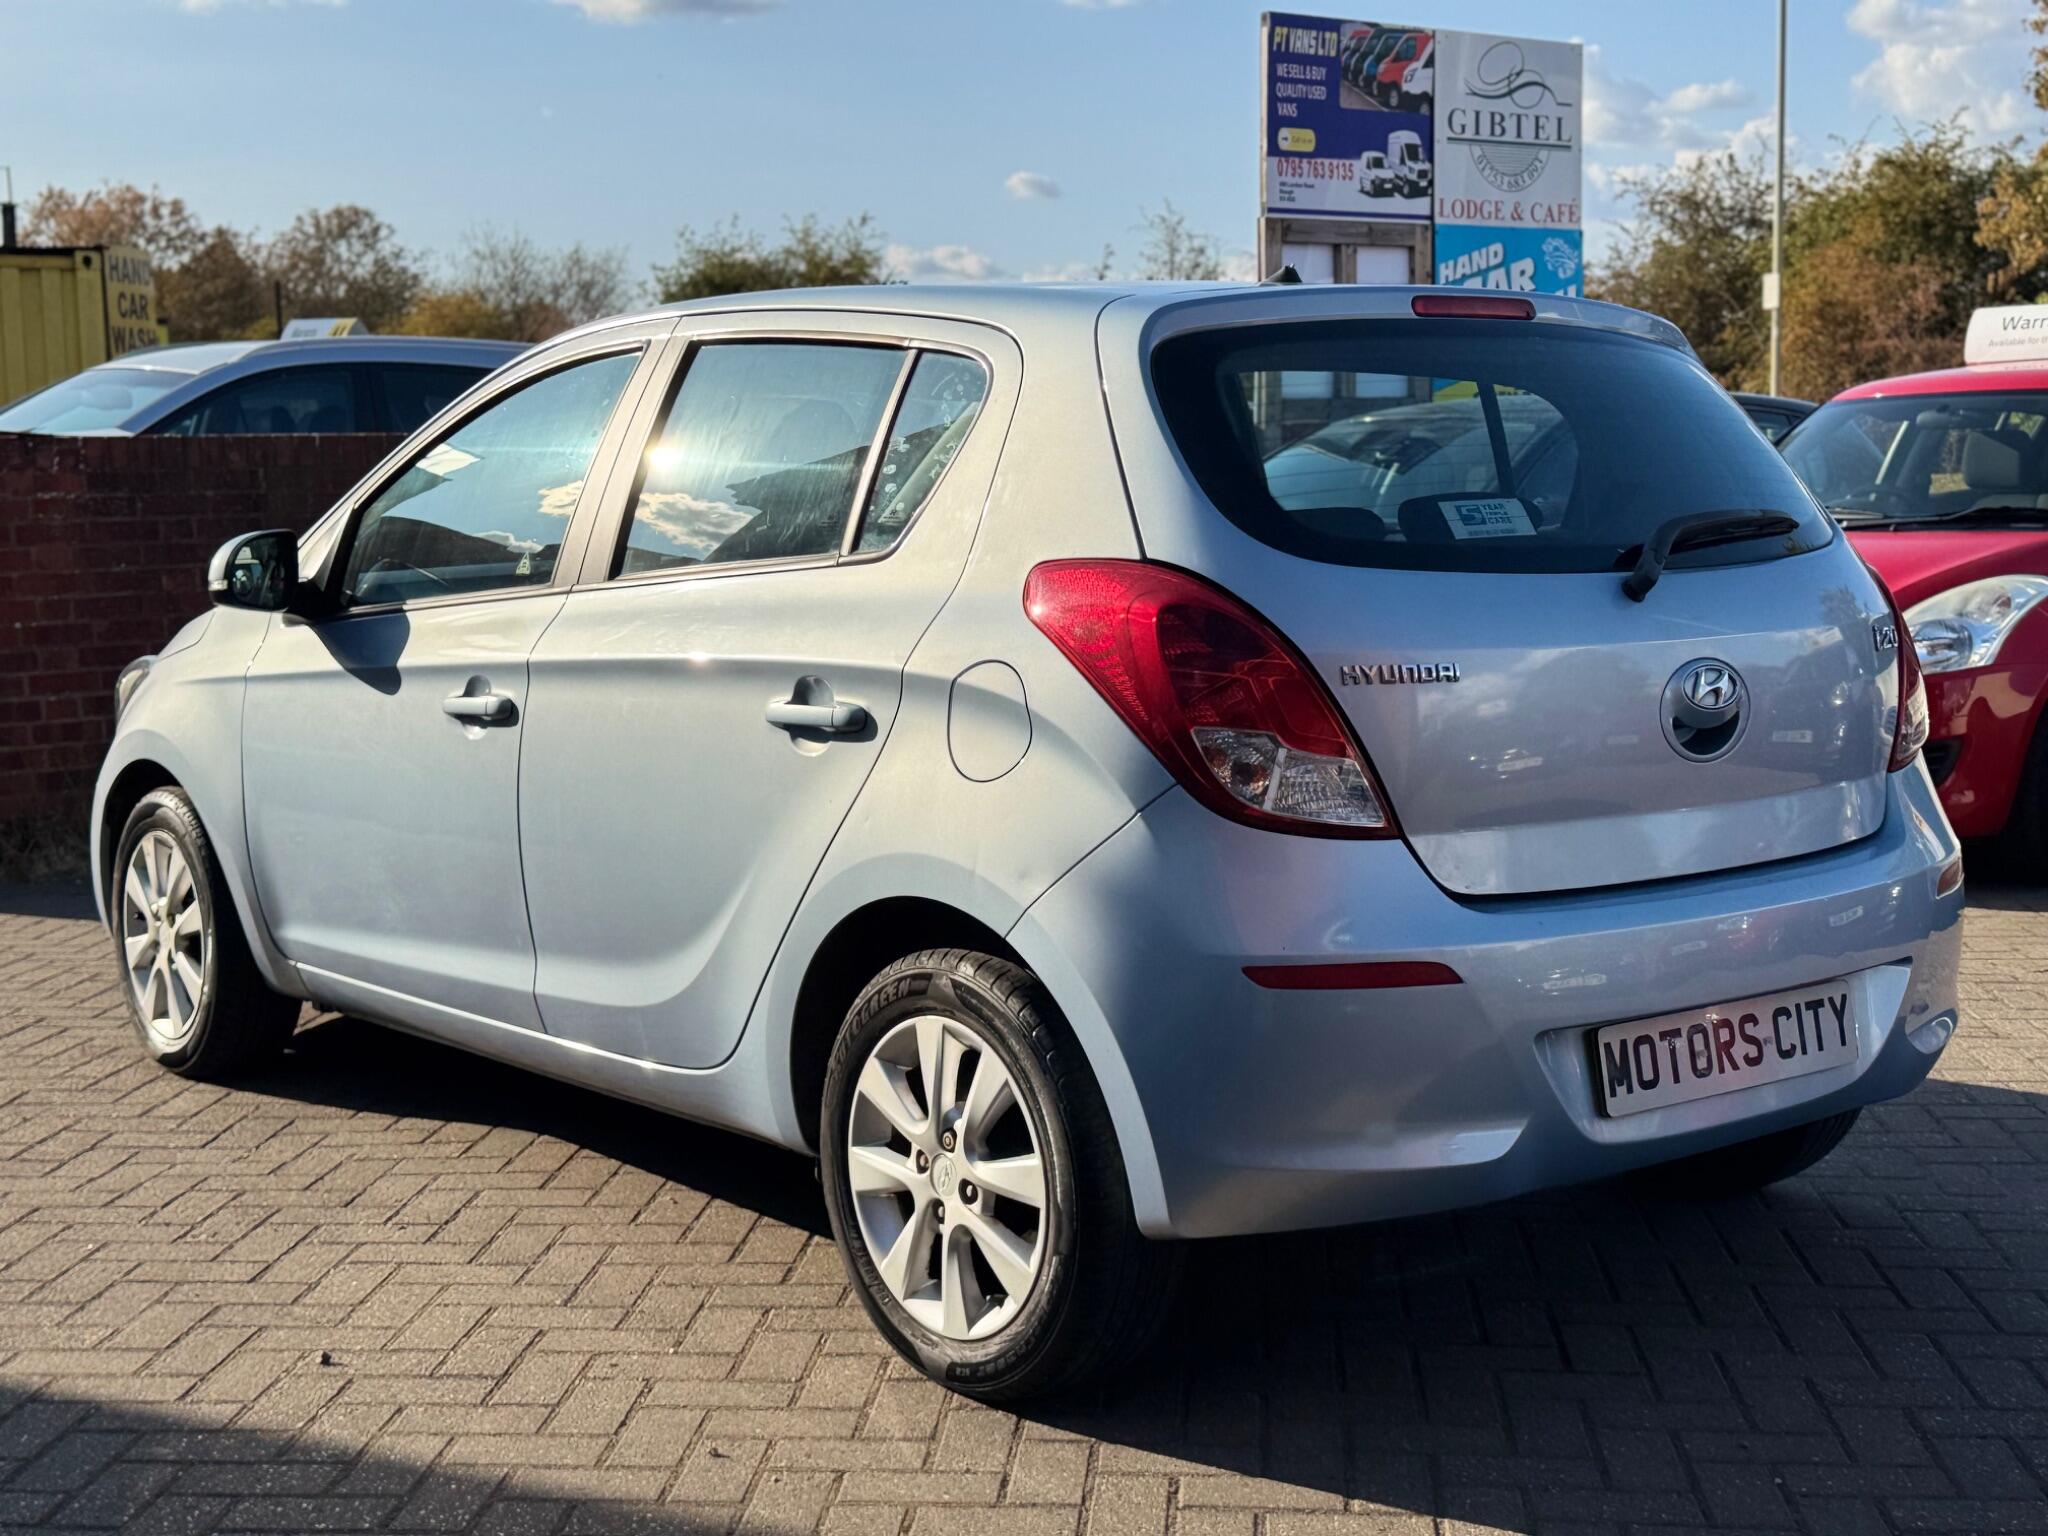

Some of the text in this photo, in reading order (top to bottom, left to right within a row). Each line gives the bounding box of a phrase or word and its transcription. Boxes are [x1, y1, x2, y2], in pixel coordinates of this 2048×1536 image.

[1273, 26, 1338, 57] PT VANS LTD
[1276, 63, 1287, 77] WE
[1288, 64, 1304, 79] SELL
[1312, 66, 1327, 80] BUY
[1276, 82, 1326, 100] QUALITY USED
[1277, 101, 1297, 117] VANS
[1447, 107, 1573, 143] GIBTEL
[1277, 158, 1354, 182] 0795 763 9135
[1438, 197, 1580, 223] LODGE & CAFÉ
[109, 255, 151, 286] HAND
[1438, 242, 1505, 285] HAND
[117, 291, 150, 321] CAR
[1872, 624, 1898, 651] i20
[1340, 662, 1460, 686] HYUNDAI
[1604, 993, 1847, 1098] MOTORS CITY
